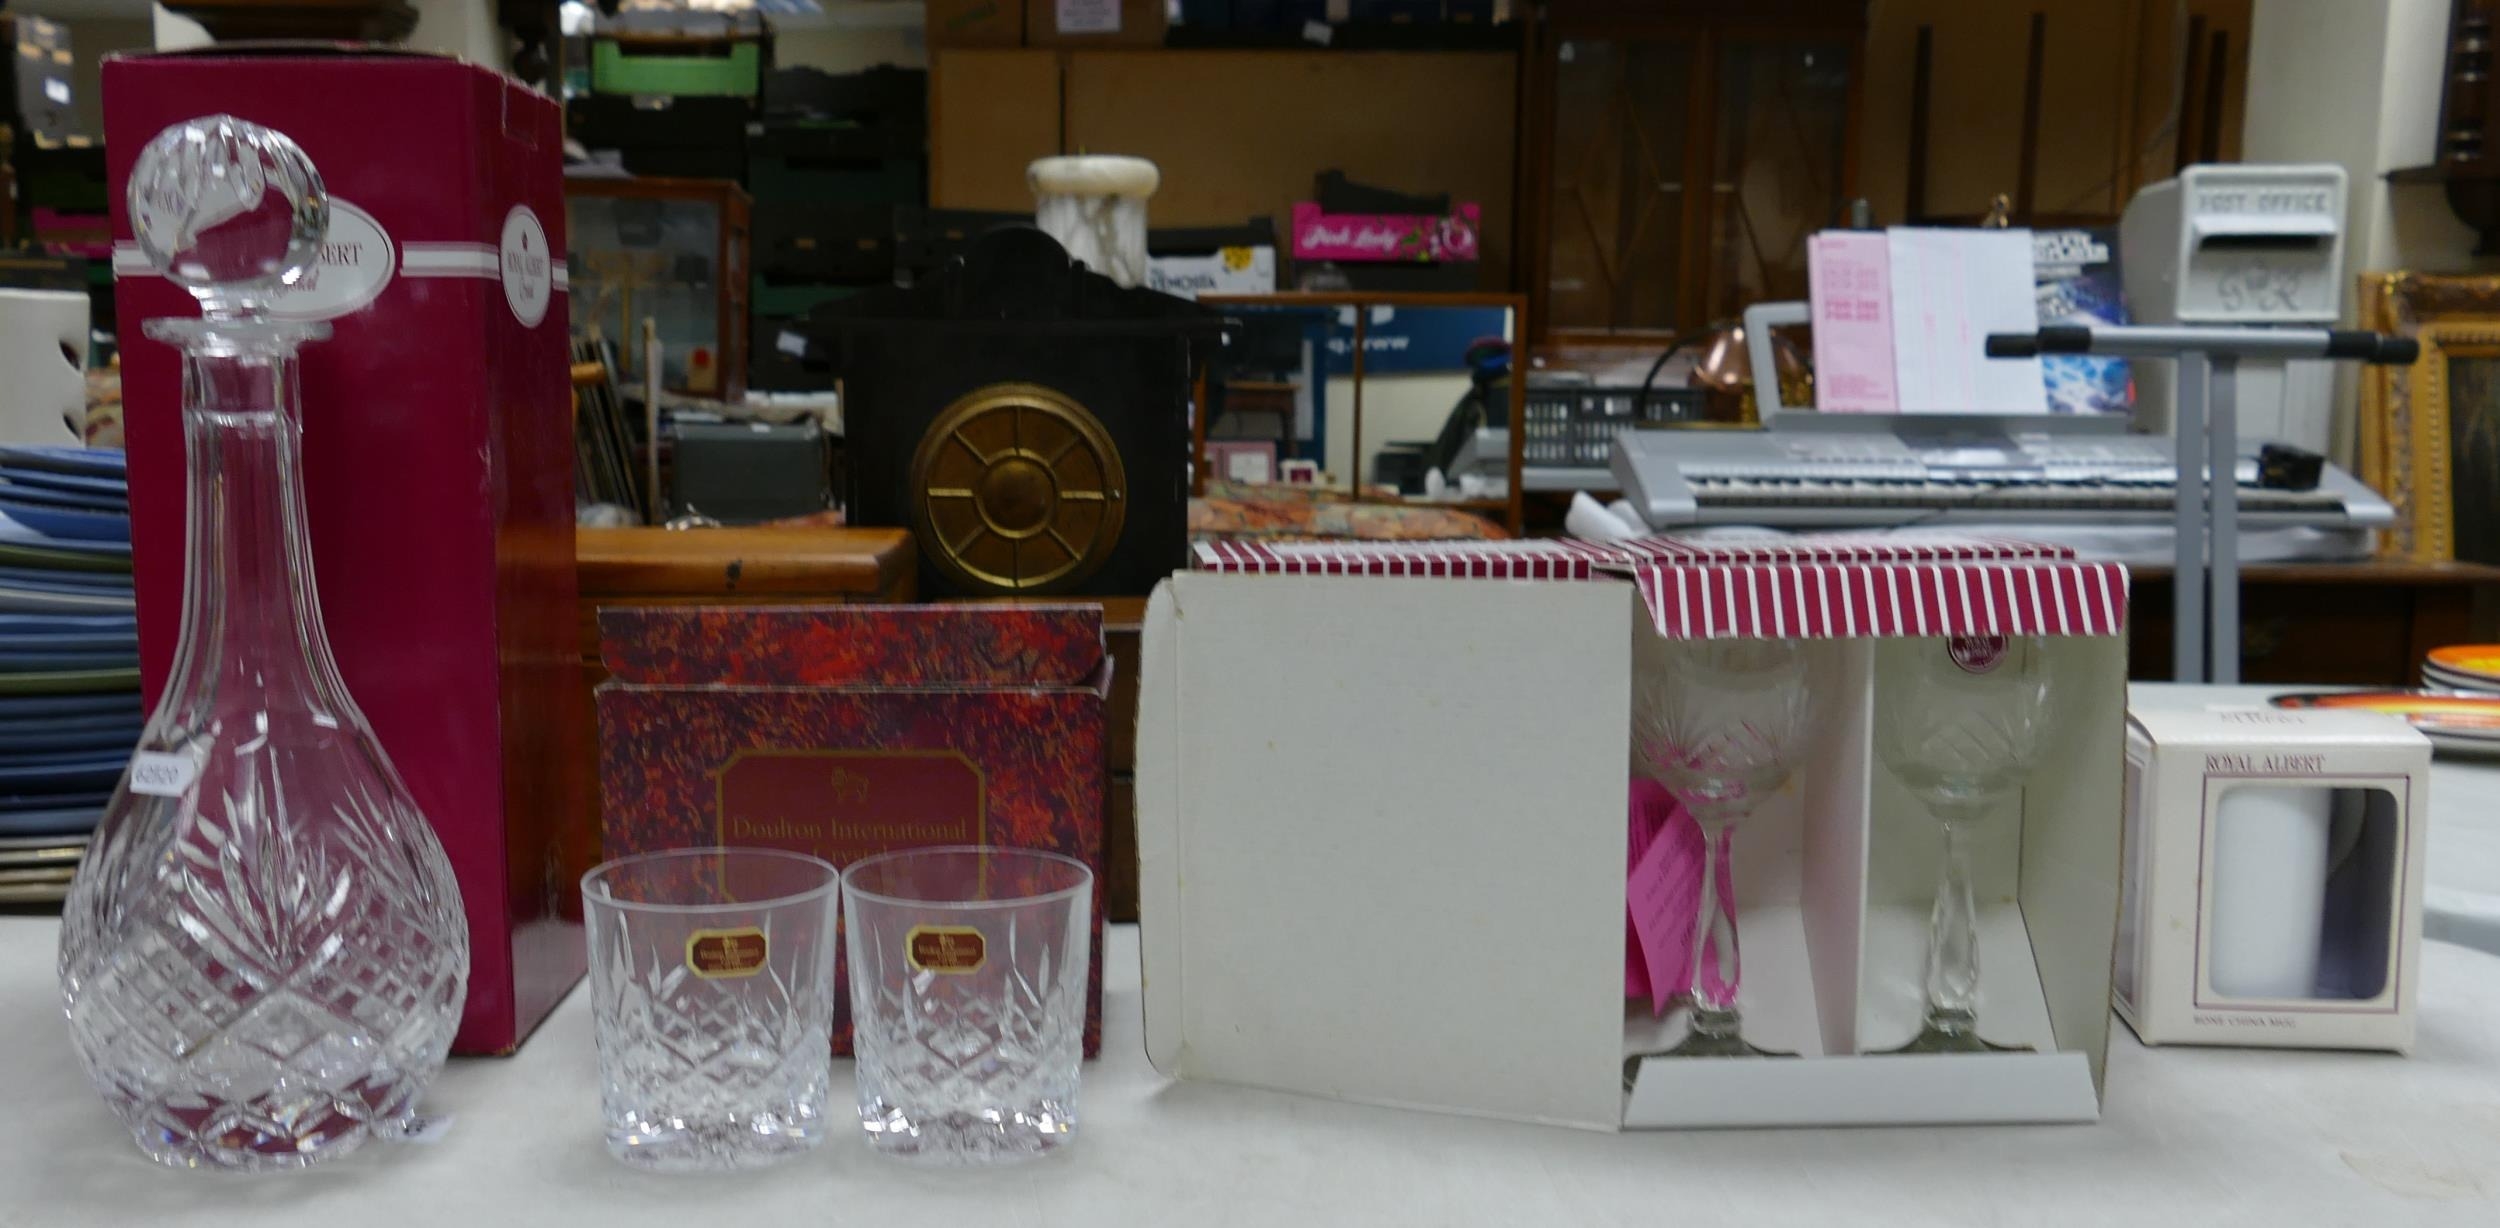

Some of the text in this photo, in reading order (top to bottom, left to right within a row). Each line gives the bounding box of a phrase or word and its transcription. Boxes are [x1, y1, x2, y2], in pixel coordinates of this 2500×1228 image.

[2199, 193, 2328, 213] POST OFFICE
[1301, 224, 1400, 251] Pink Lady
[318, 243, 362, 265] BERT
[2205, 752, 2326, 774] ROYAL ALBERT
[733, 815, 968, 841] Doulton International
